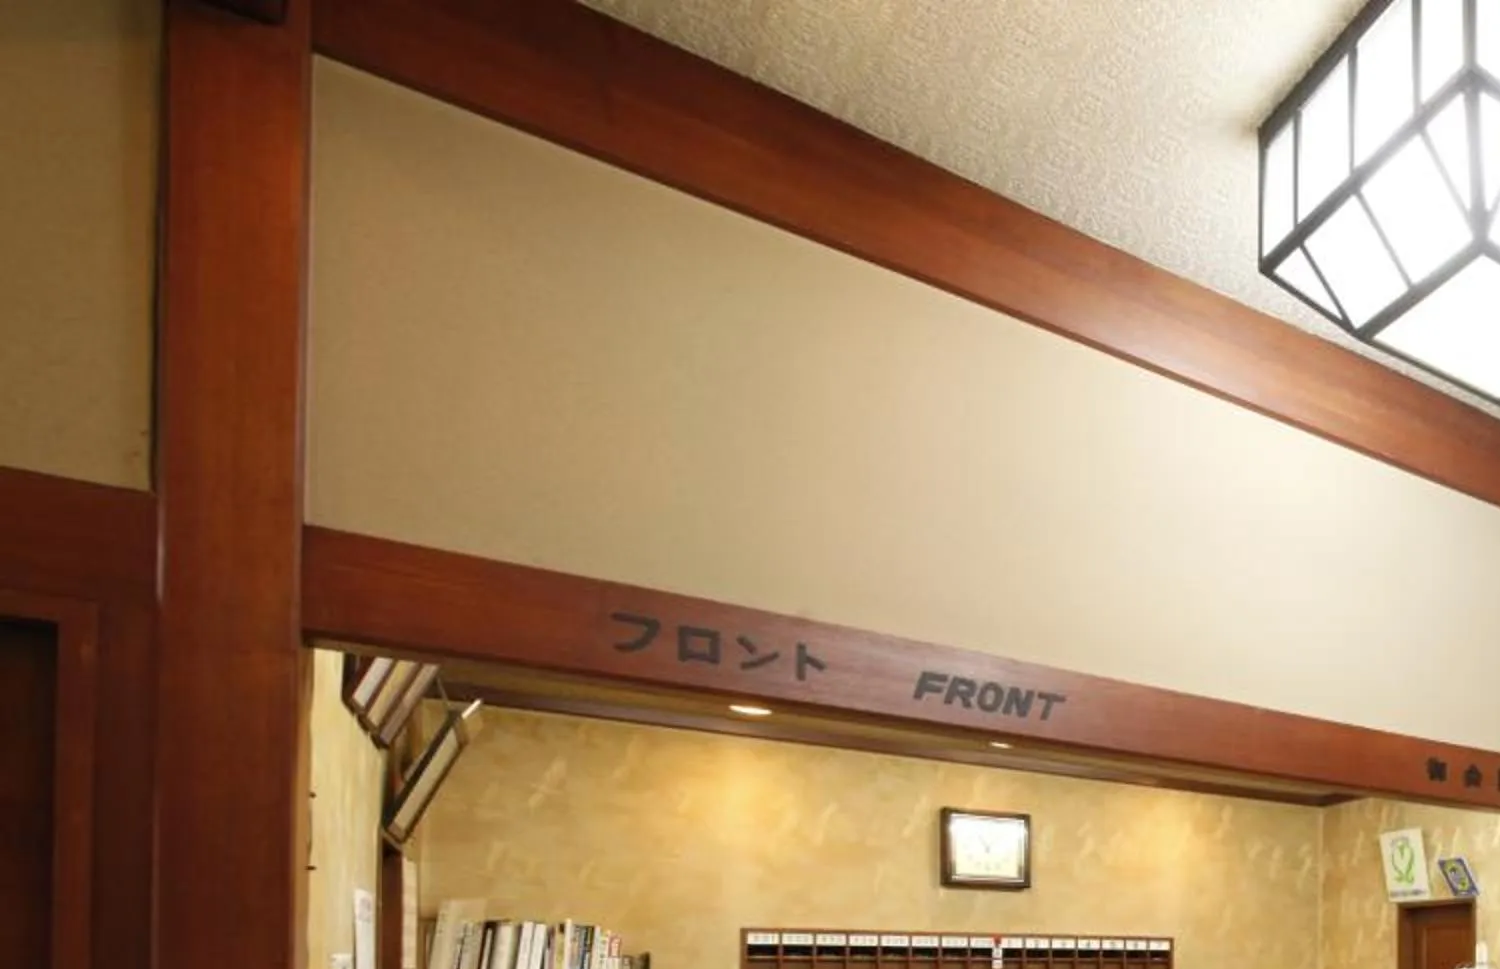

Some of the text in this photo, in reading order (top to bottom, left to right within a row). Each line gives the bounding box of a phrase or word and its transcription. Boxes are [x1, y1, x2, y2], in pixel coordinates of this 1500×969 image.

[610, 611, 1067, 722] フロント FRONT
